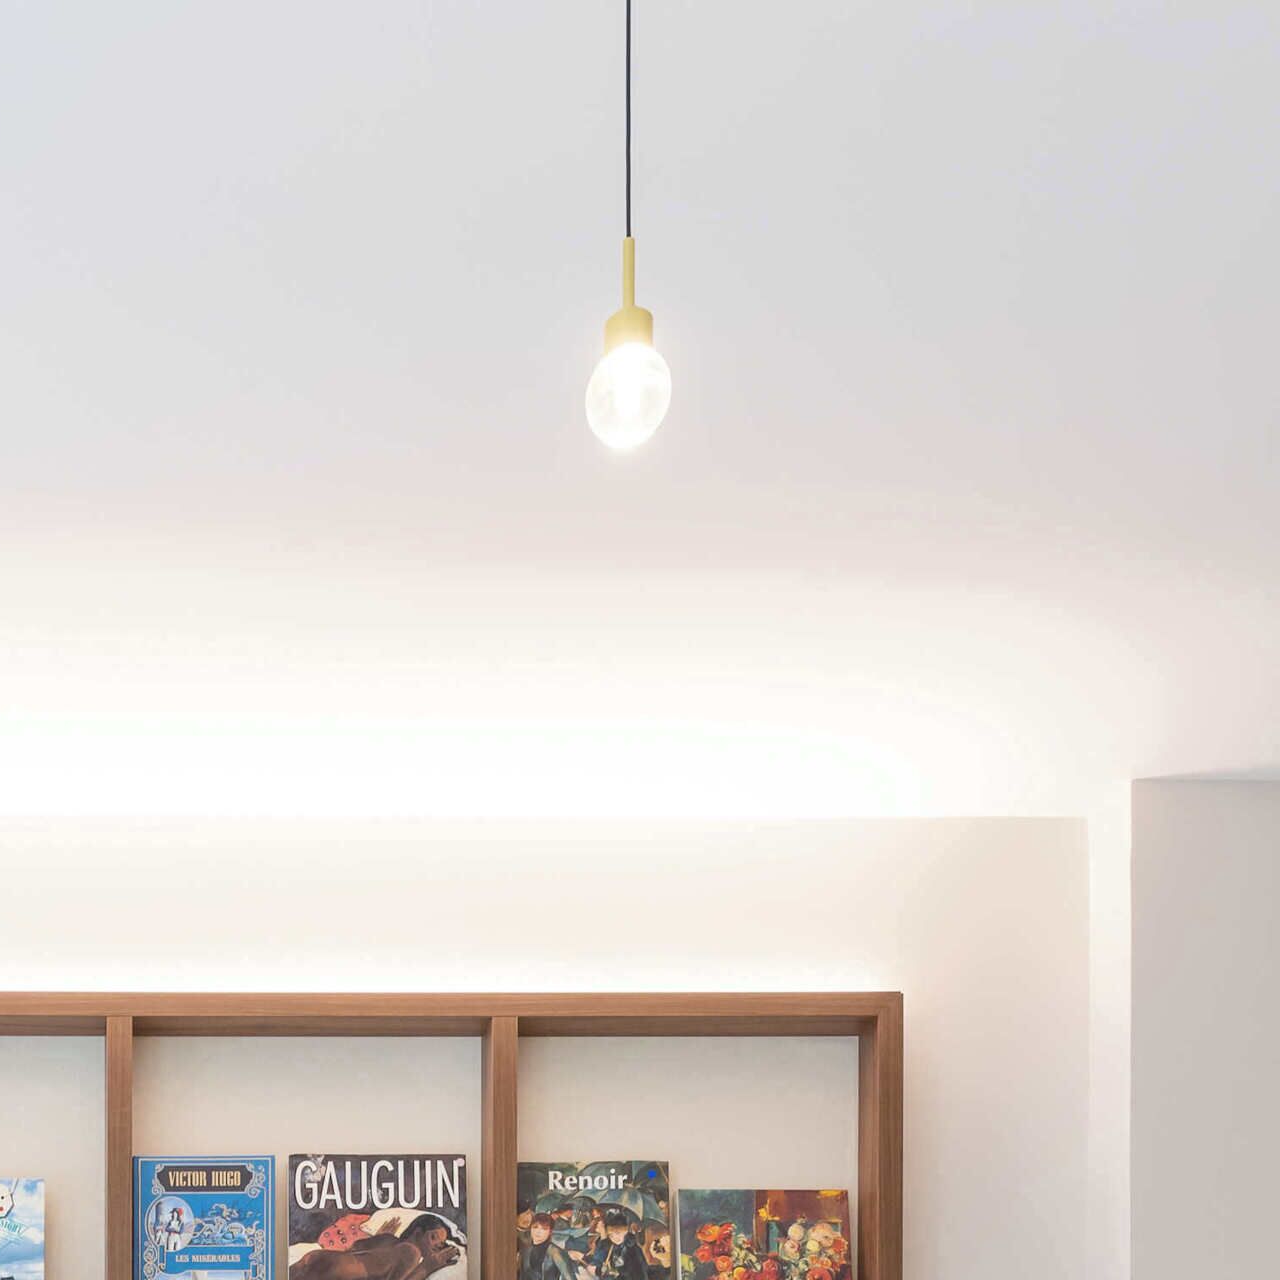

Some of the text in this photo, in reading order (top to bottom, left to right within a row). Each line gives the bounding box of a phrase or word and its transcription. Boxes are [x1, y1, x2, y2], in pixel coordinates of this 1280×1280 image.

[169, 1171, 241, 1187] VICTOR HUGO
[295, 1160, 460, 1209] GAUGUIN
[548, 1168, 628, 1190] Renoir
